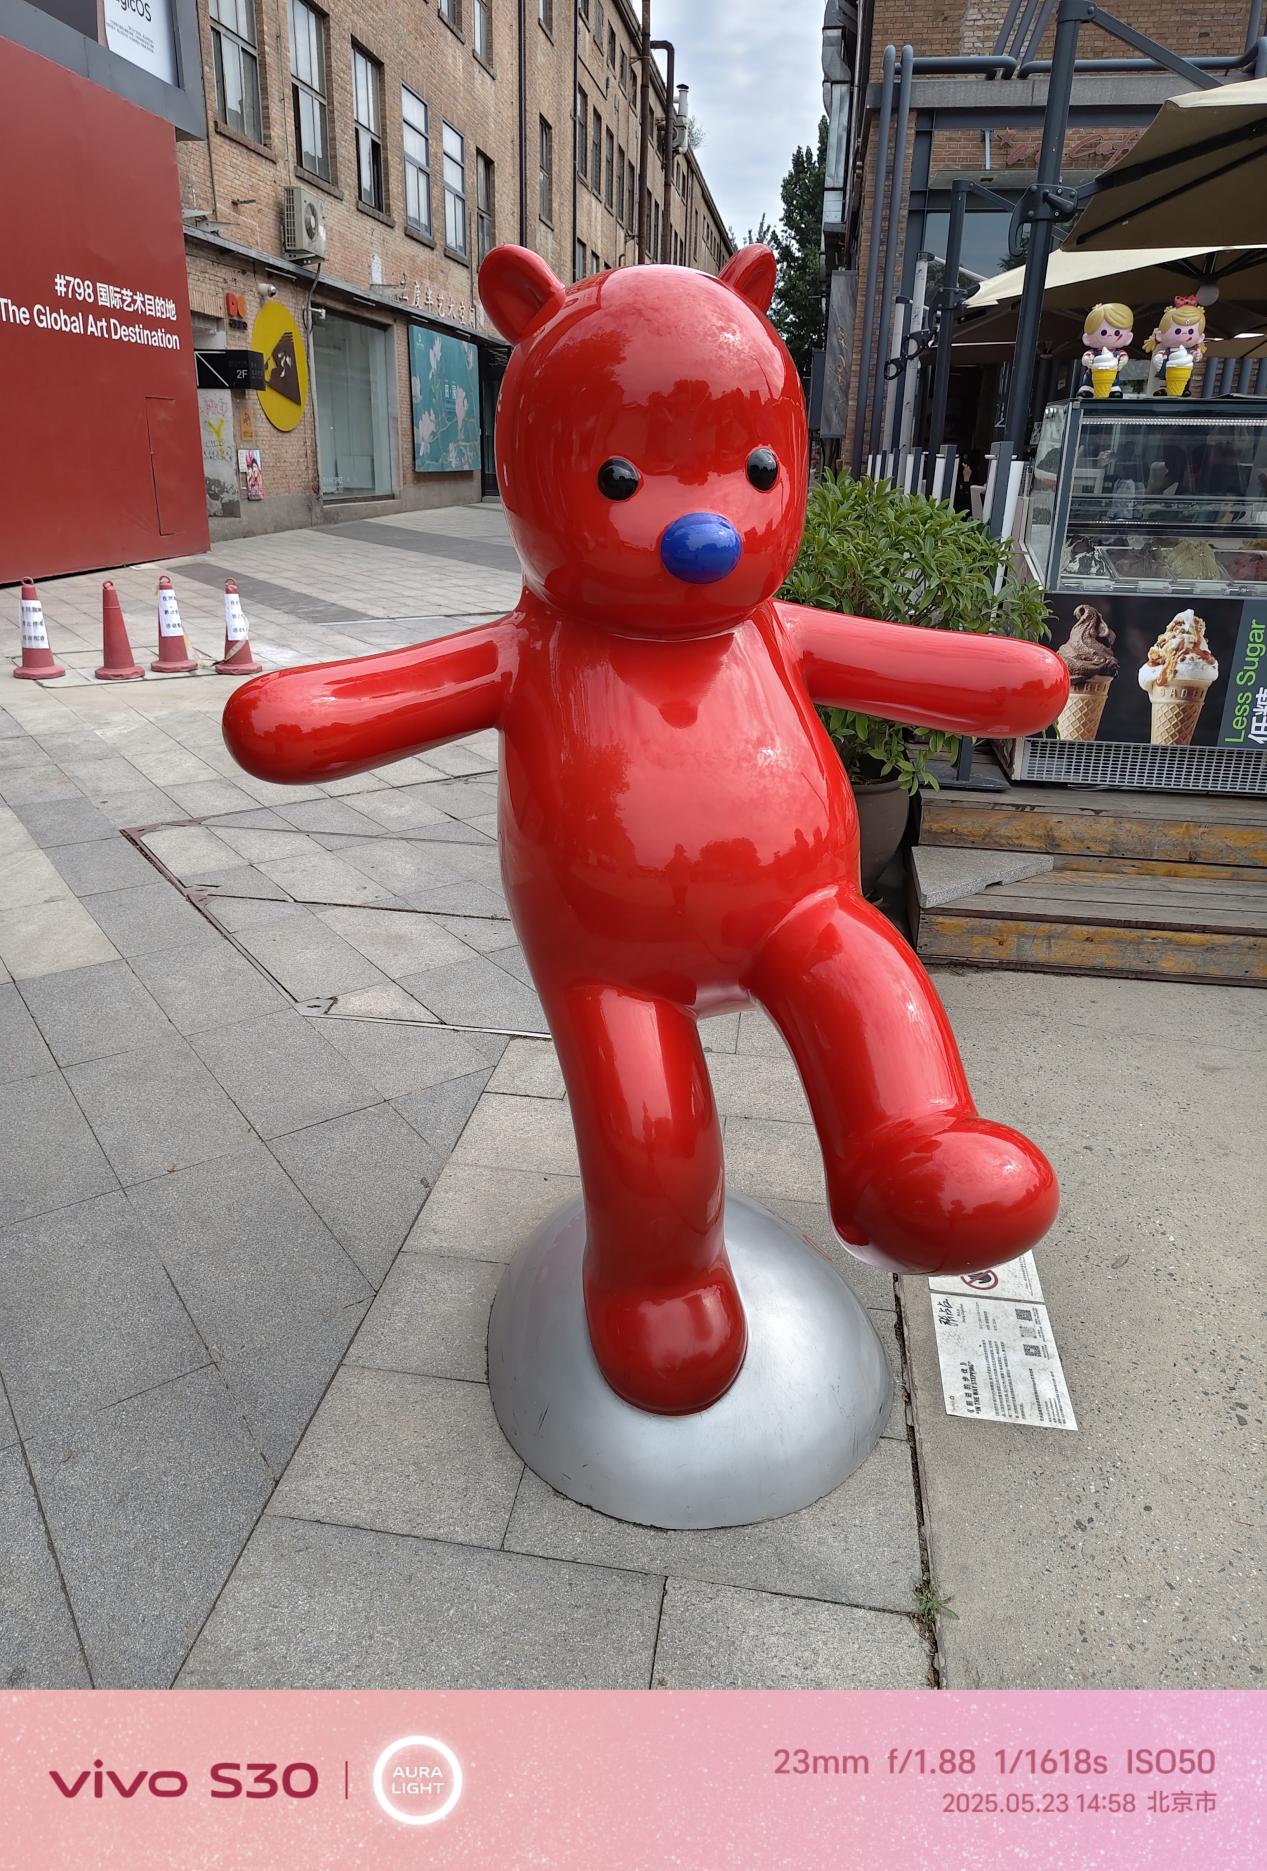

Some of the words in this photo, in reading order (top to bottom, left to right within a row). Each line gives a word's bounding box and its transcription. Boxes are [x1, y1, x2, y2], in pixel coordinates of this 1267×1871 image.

[54, 274, 94, 302] #798
[96, 282, 177, 321] 国际艺术目的地
[0, 298, 30, 326] The
[33, 304, 84, 335] Global
[87, 314, 108, 339] Art
[110, 319, 180, 350] Destination
[236, 369, 248, 379] 2F
[1236, 619, 1266, 686] Sugar
[1225, 692, 1252, 742] Less
